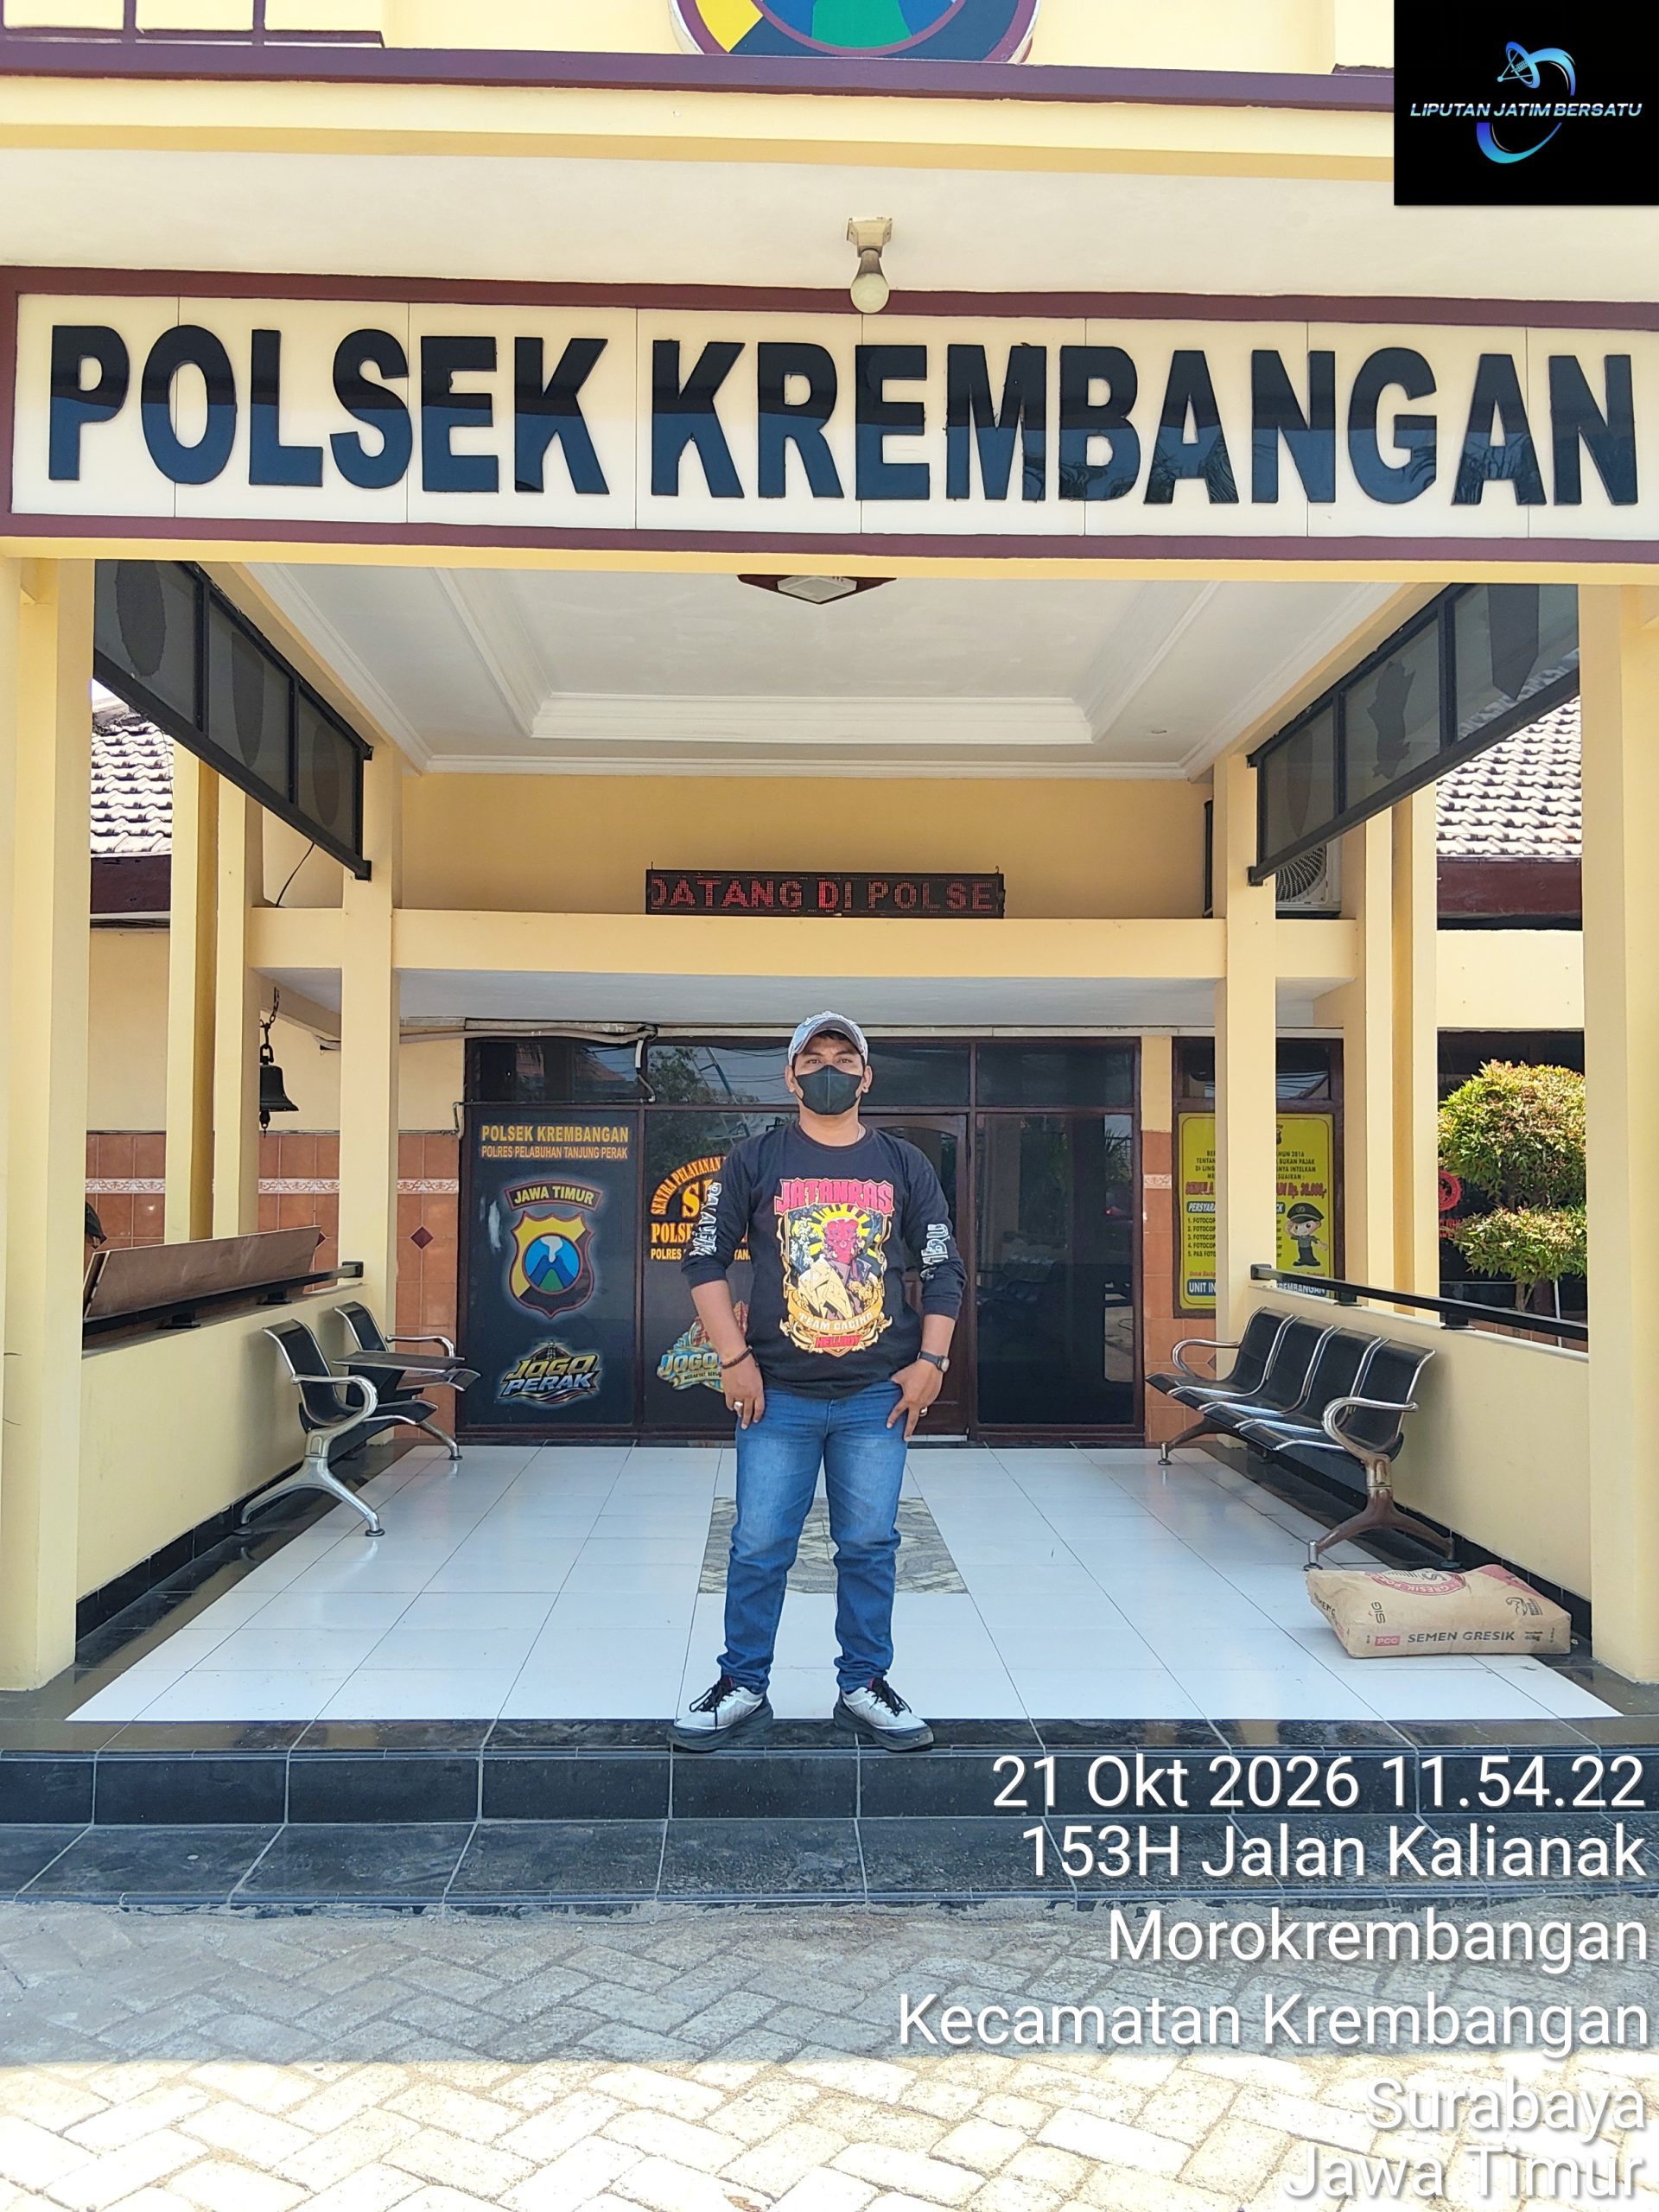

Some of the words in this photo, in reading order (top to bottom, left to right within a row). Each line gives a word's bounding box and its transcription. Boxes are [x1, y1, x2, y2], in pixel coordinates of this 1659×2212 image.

[48, 324, 610, 495] POLSEK
[651, 338, 1638, 506] KREMBANGAN
[818, 880, 852, 910] DI
[481, 1125, 534, 1141] POLSEK
[537, 1126, 629, 1143] KREMBANGAN
[481, 1146, 513, 1159] POLRES
[514, 1146, 563, 1159] PELABUHAN
[563, 1147, 600, 1160] TANJUNG
[601, 1147, 629, 1160] PERAK
[514, 1186, 550, 1205] JAWA
[551, 1186, 595, 1205] TIMUR
[651, 1178, 677, 1216] SENTRA
[671, 1155, 722, 1186] PELAYANAN
[775, 1178, 894, 1217] JATANRAS
[651, 1248, 683, 1261] POLRES
[1189, 1281, 1207, 1294] UNIT
[799, 1312, 830, 1331] TEAM
[505, 1354, 597, 1380] JOGO
[657, 1352, 719, 1379] JOGO
[501, 1371, 596, 1396] PERAK
[1408, 1631, 1459, 1643] SEMEN
[1462, 1630, 1516, 1642] GRESIK
